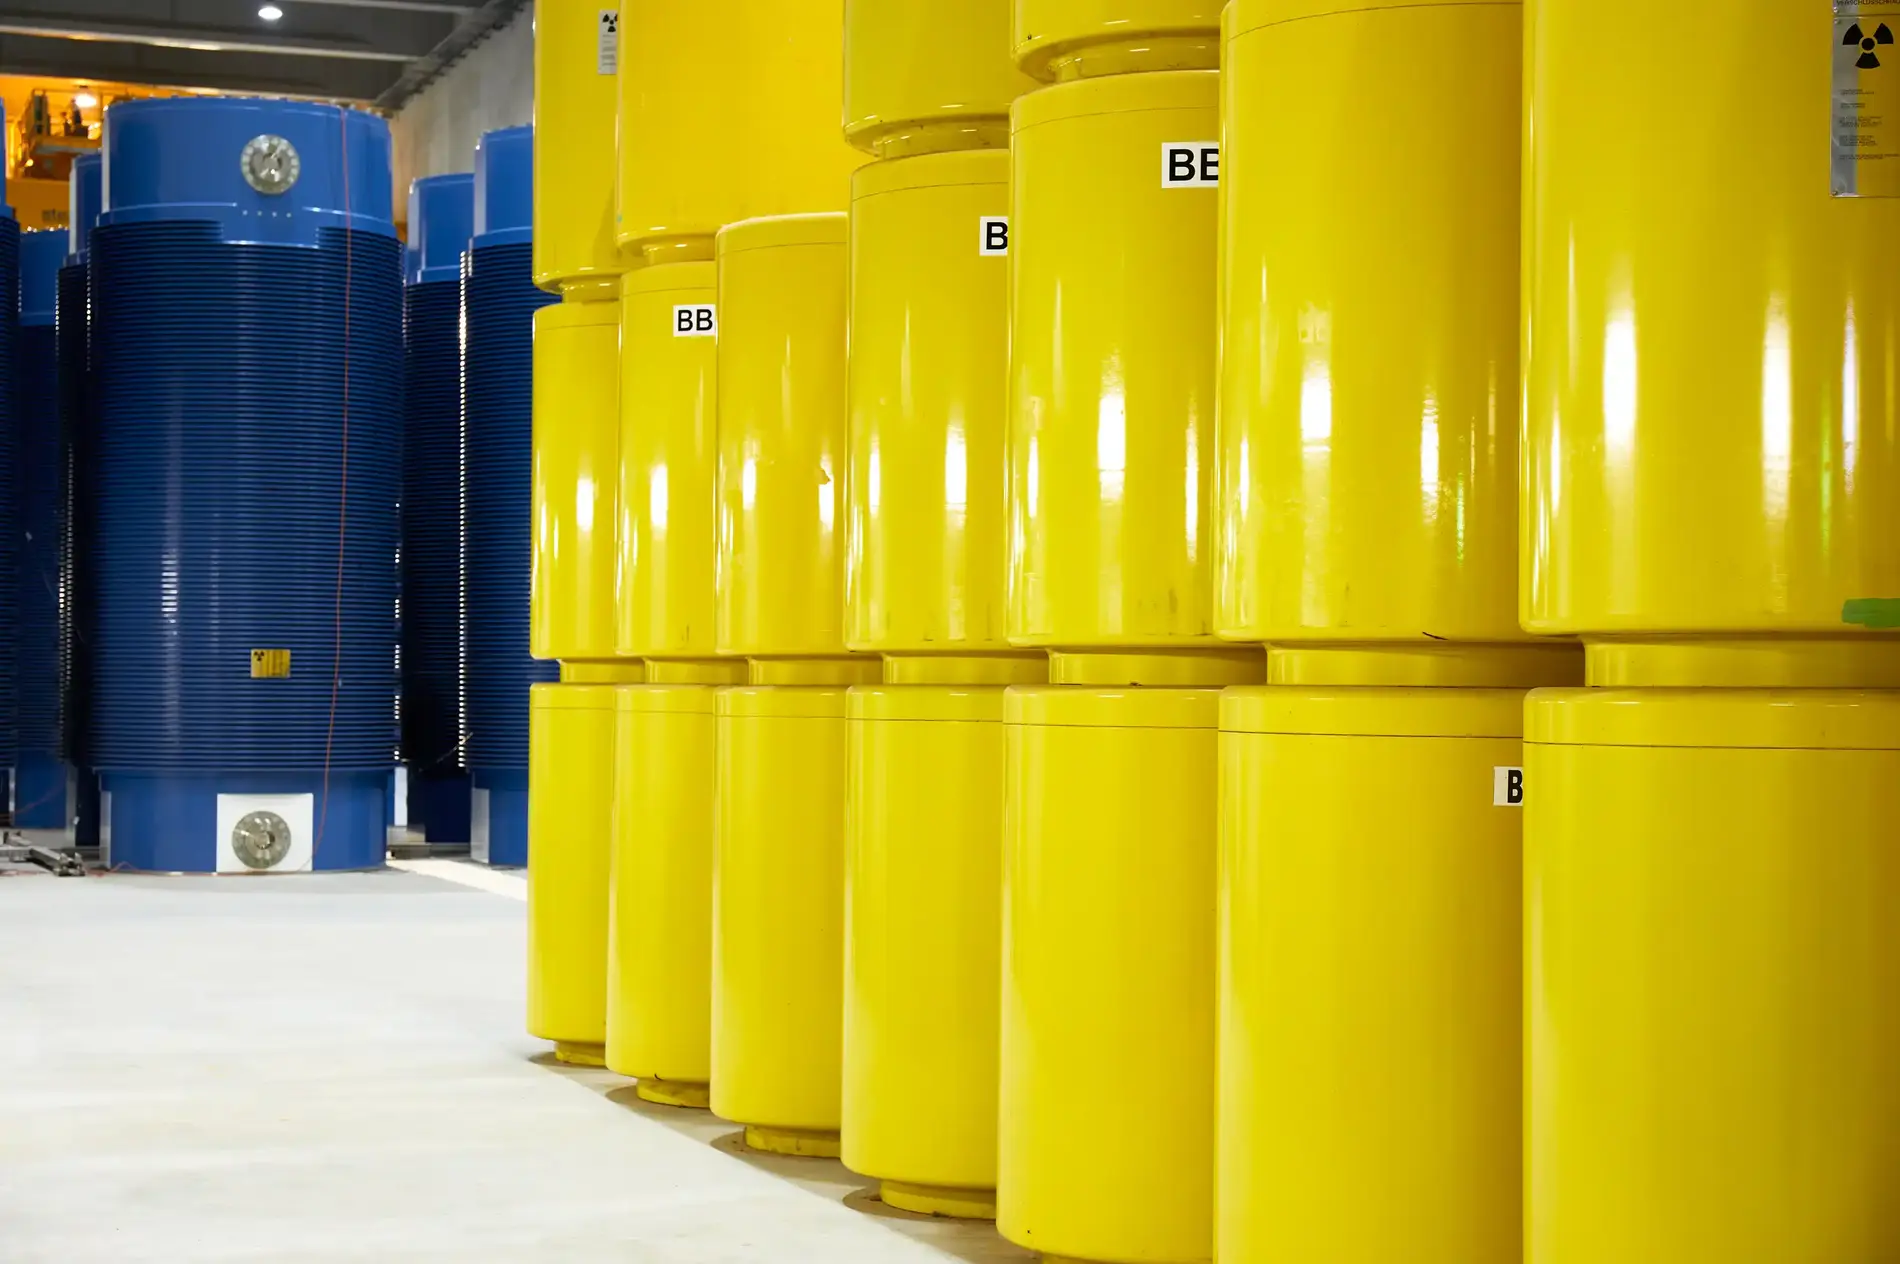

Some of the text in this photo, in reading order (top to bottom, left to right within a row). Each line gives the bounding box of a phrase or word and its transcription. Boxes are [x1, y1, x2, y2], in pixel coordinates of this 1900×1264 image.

[986, 221, 1008, 250] B
[678, 309, 713, 331] BB
[1507, 769, 1523, 803] B
